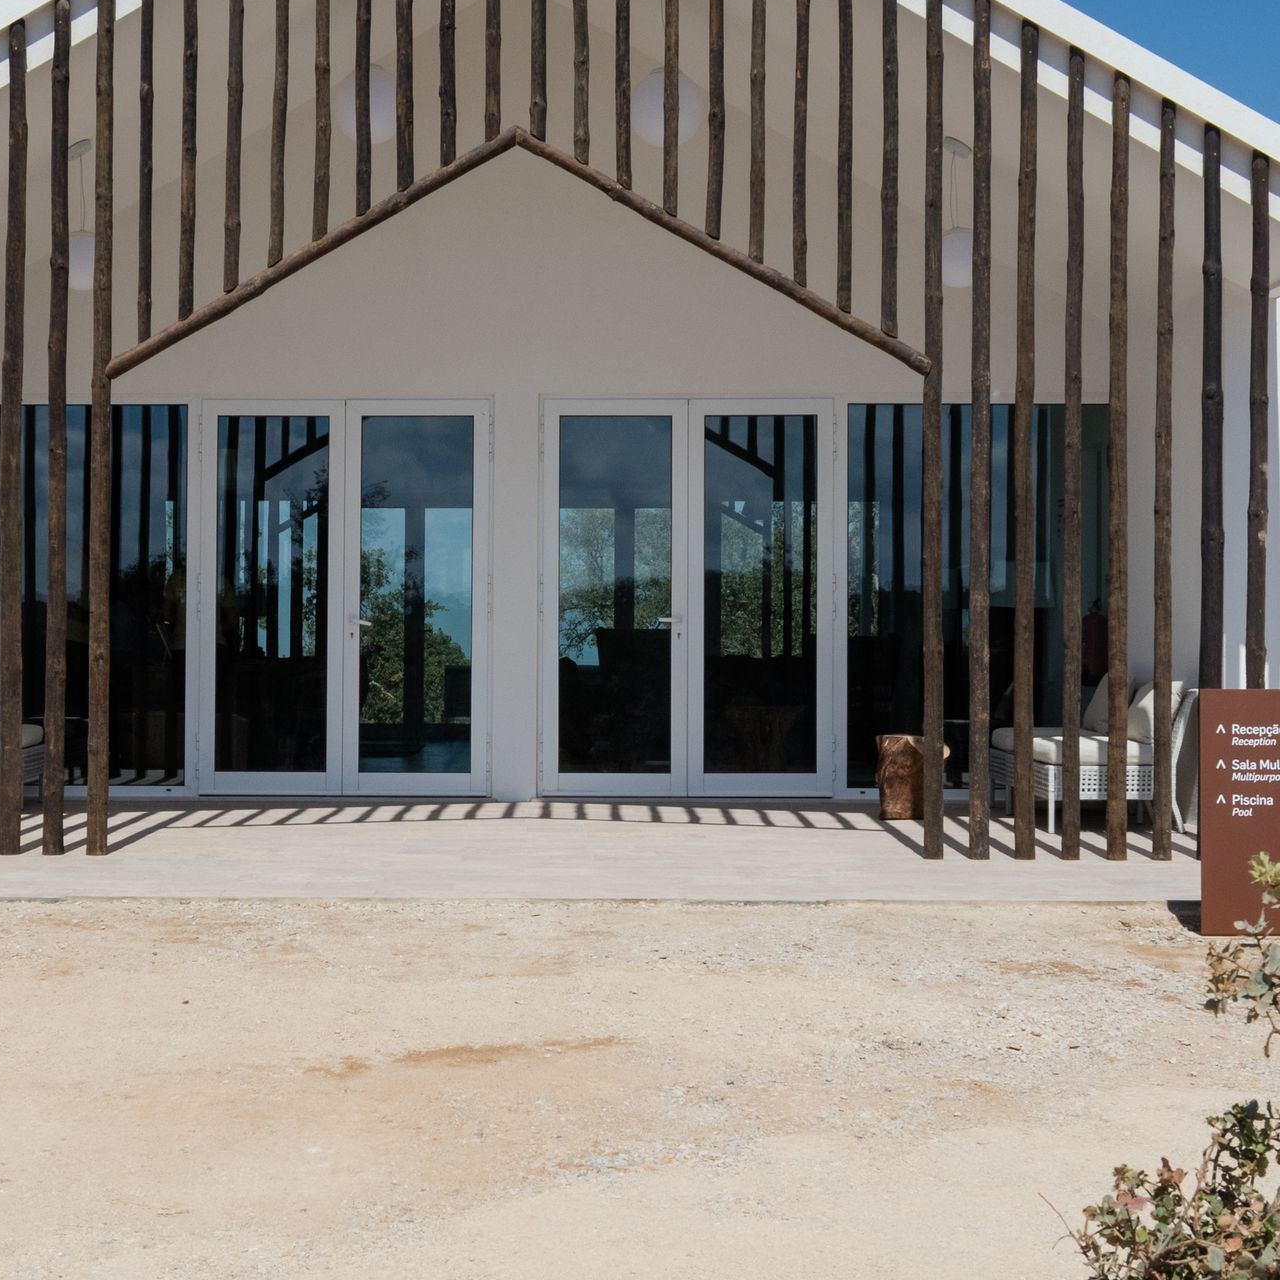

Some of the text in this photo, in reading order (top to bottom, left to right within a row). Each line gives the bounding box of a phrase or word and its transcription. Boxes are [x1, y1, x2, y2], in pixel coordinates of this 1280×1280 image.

[1231, 737, 1277, 747] Reception
[1231, 759, 1257, 771] Sala
[1231, 794, 1274, 806] Piscina
[1231, 807, 1253, 817] Pool
